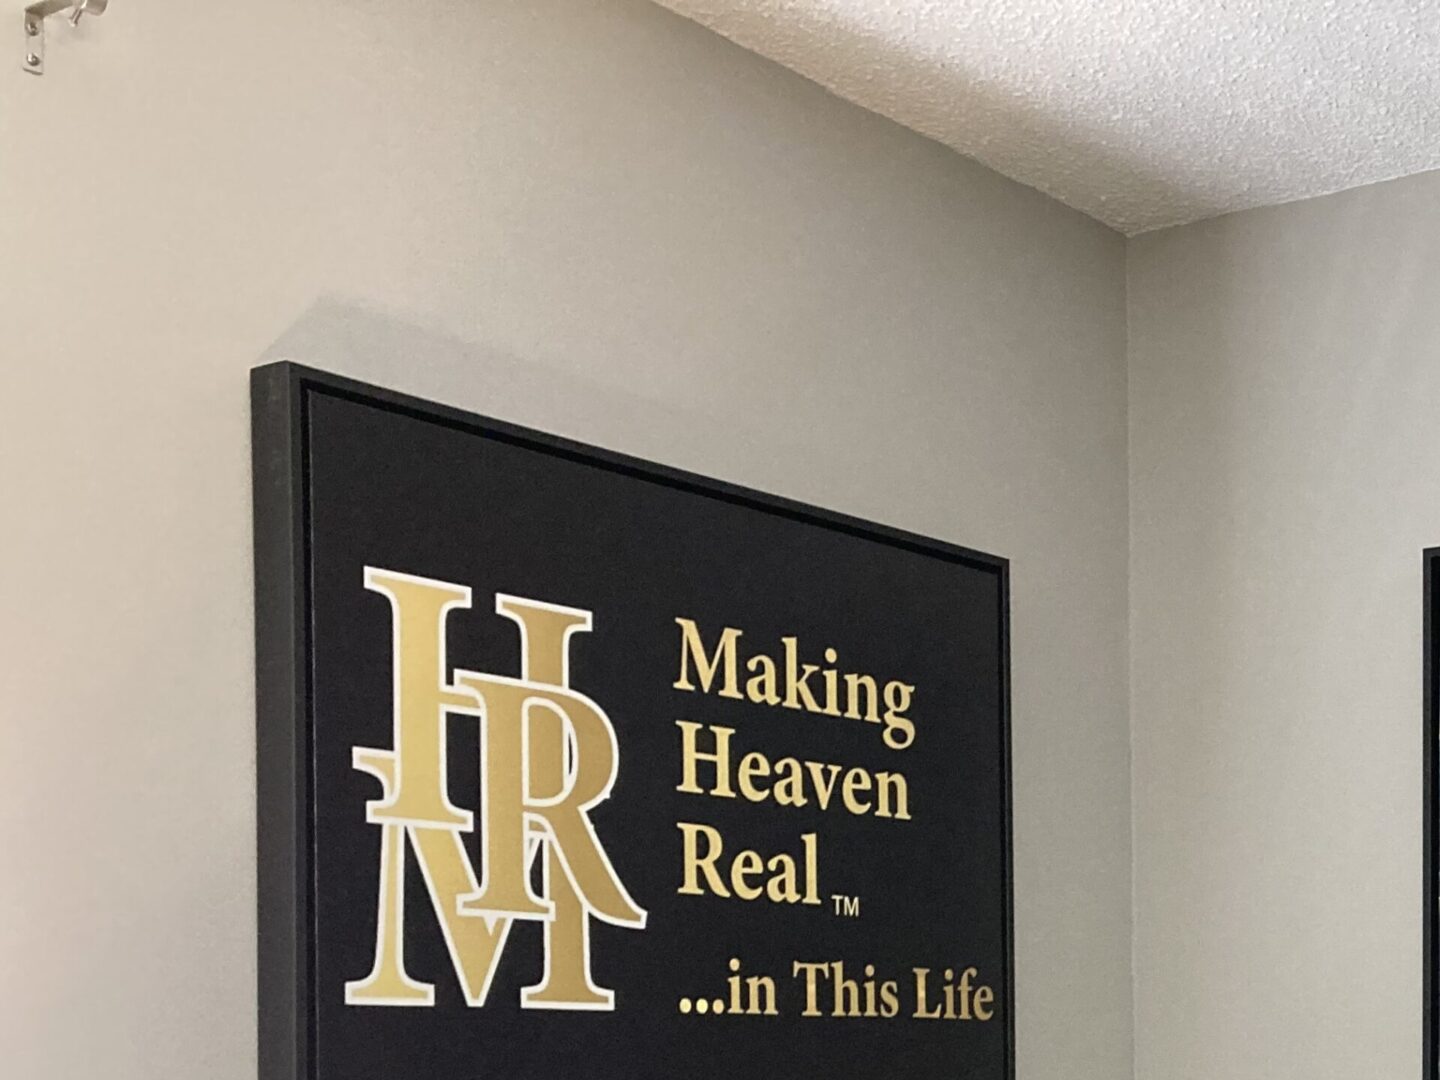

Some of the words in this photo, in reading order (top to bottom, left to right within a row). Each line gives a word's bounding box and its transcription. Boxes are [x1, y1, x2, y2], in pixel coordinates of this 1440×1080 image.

[673, 617, 915, 749] Making
[675, 720, 911, 820] Heaven
[677, 822, 821, 905] Real
[679, 958, 778, 1016] ...in
[793, 961, 899, 1018] This
[912, 967, 994, 1021] Life
